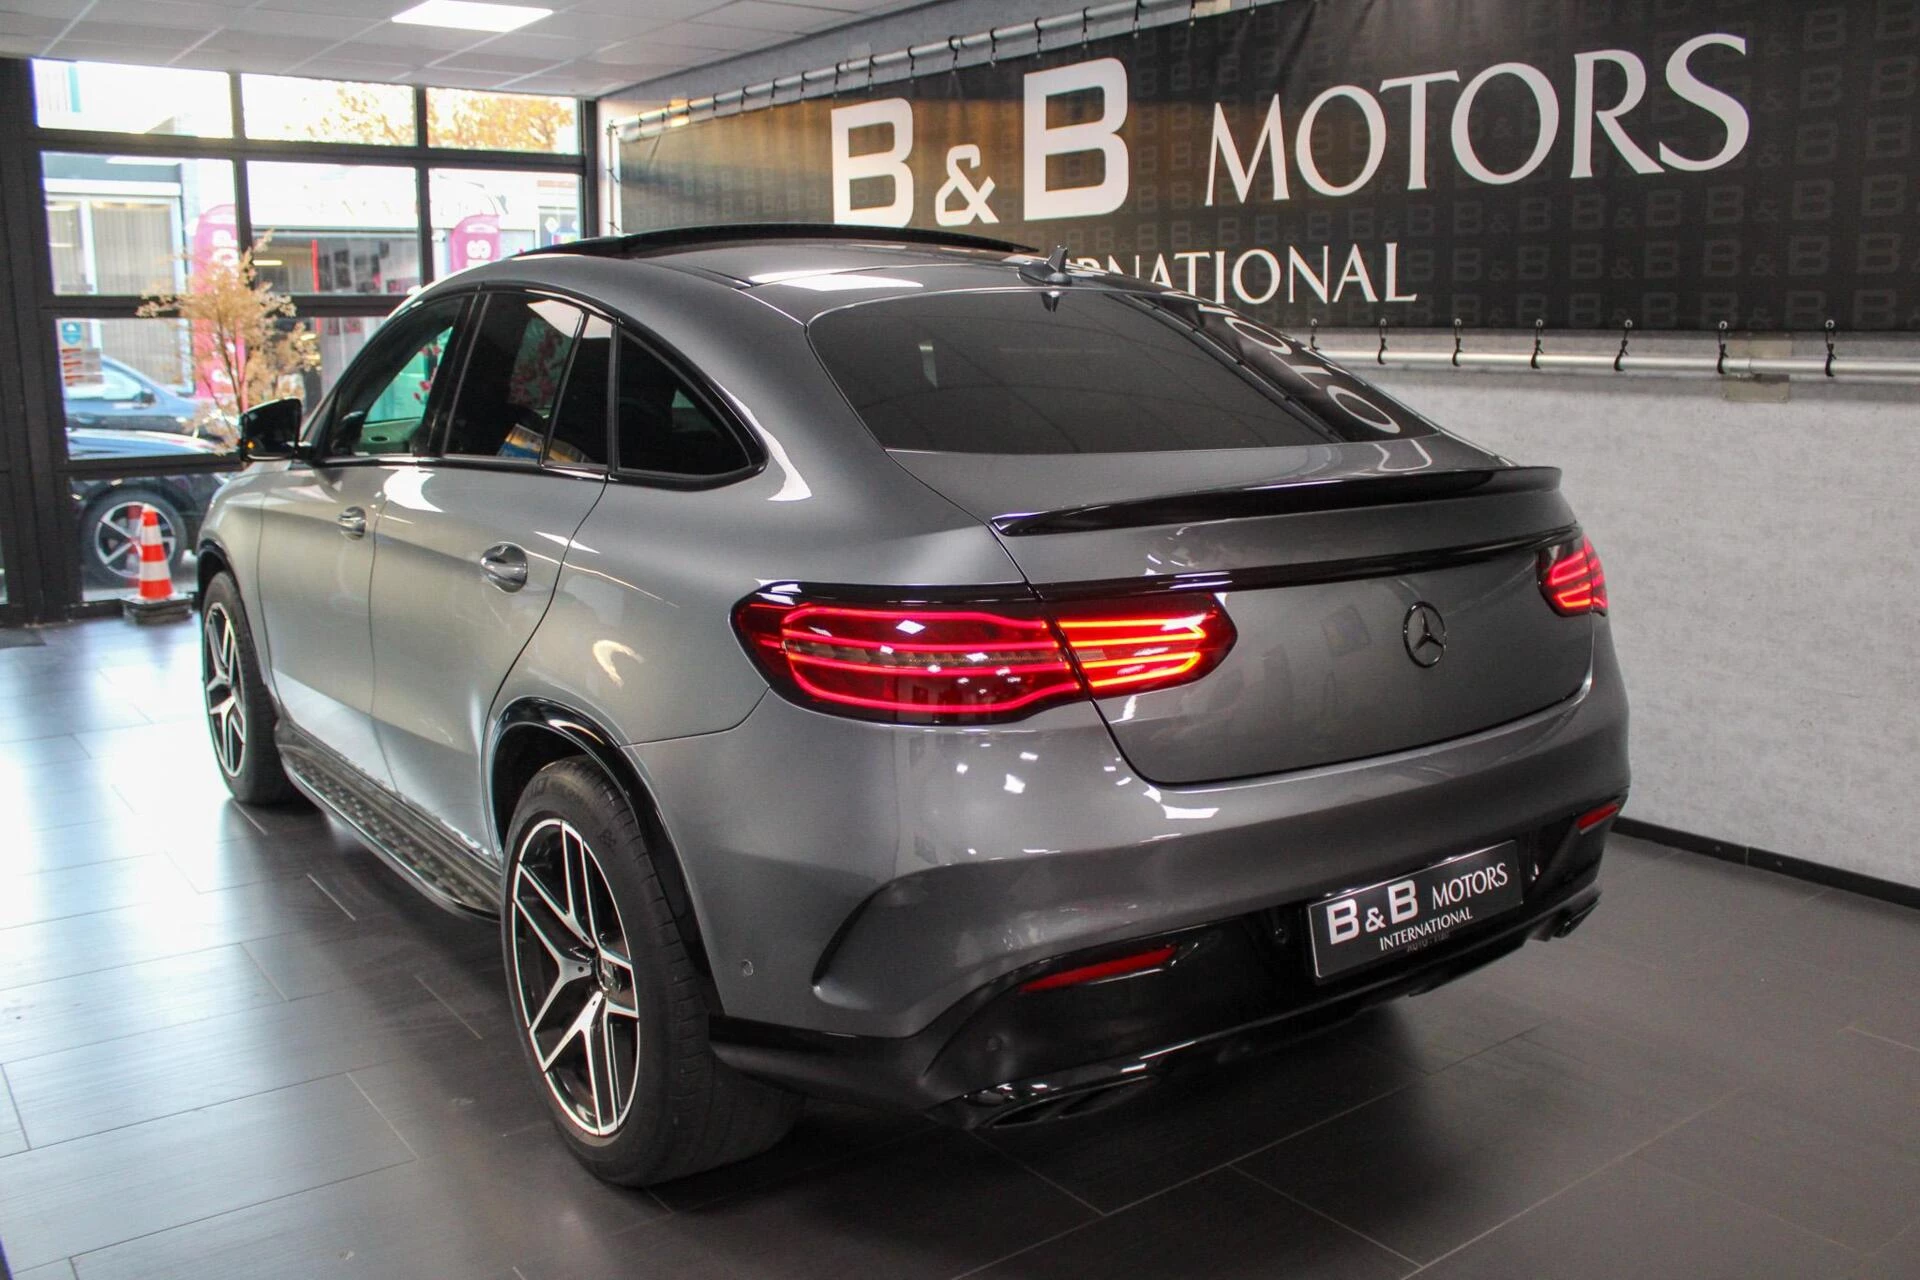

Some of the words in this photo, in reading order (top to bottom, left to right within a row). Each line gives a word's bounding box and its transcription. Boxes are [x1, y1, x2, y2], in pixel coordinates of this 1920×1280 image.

[1205, 32, 1751, 207] MOTORS
[1077, 242, 1418, 304] ATIONAL
[1326, 880, 1419, 945] B&B
[1432, 862, 1508, 910] MOTORS
[1380, 906, 1473, 951] INTERNATIONAL
